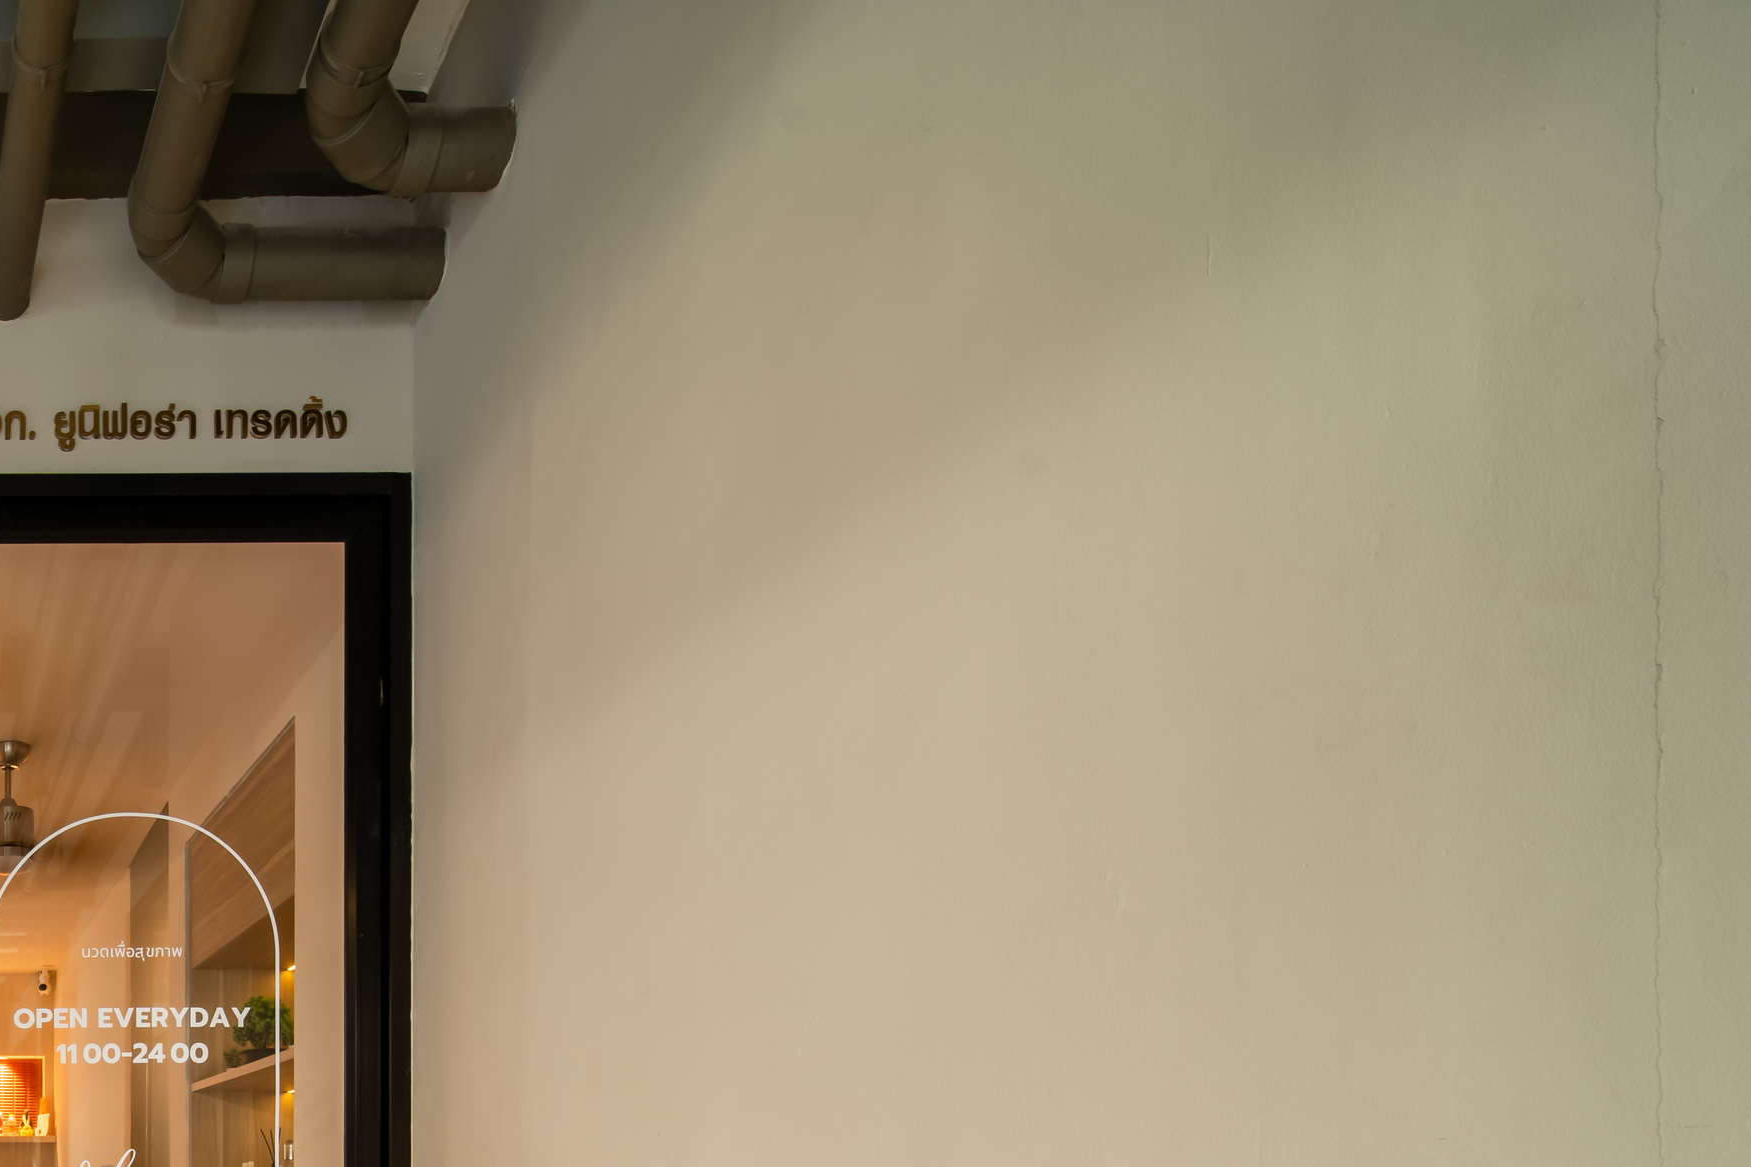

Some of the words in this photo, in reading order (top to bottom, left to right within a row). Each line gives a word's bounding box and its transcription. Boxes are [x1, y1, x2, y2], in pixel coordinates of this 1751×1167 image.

[53, 402, 197, 451] ยูนิฟอร่า
[213, 395, 348, 440] เทรดดิ้ง
[81, 941, 183, 962] นวดเพื่อสุขภาพ
[13, 1007, 88, 1029] OPEN
[98, 1007, 251, 1028] EVERYDAY
